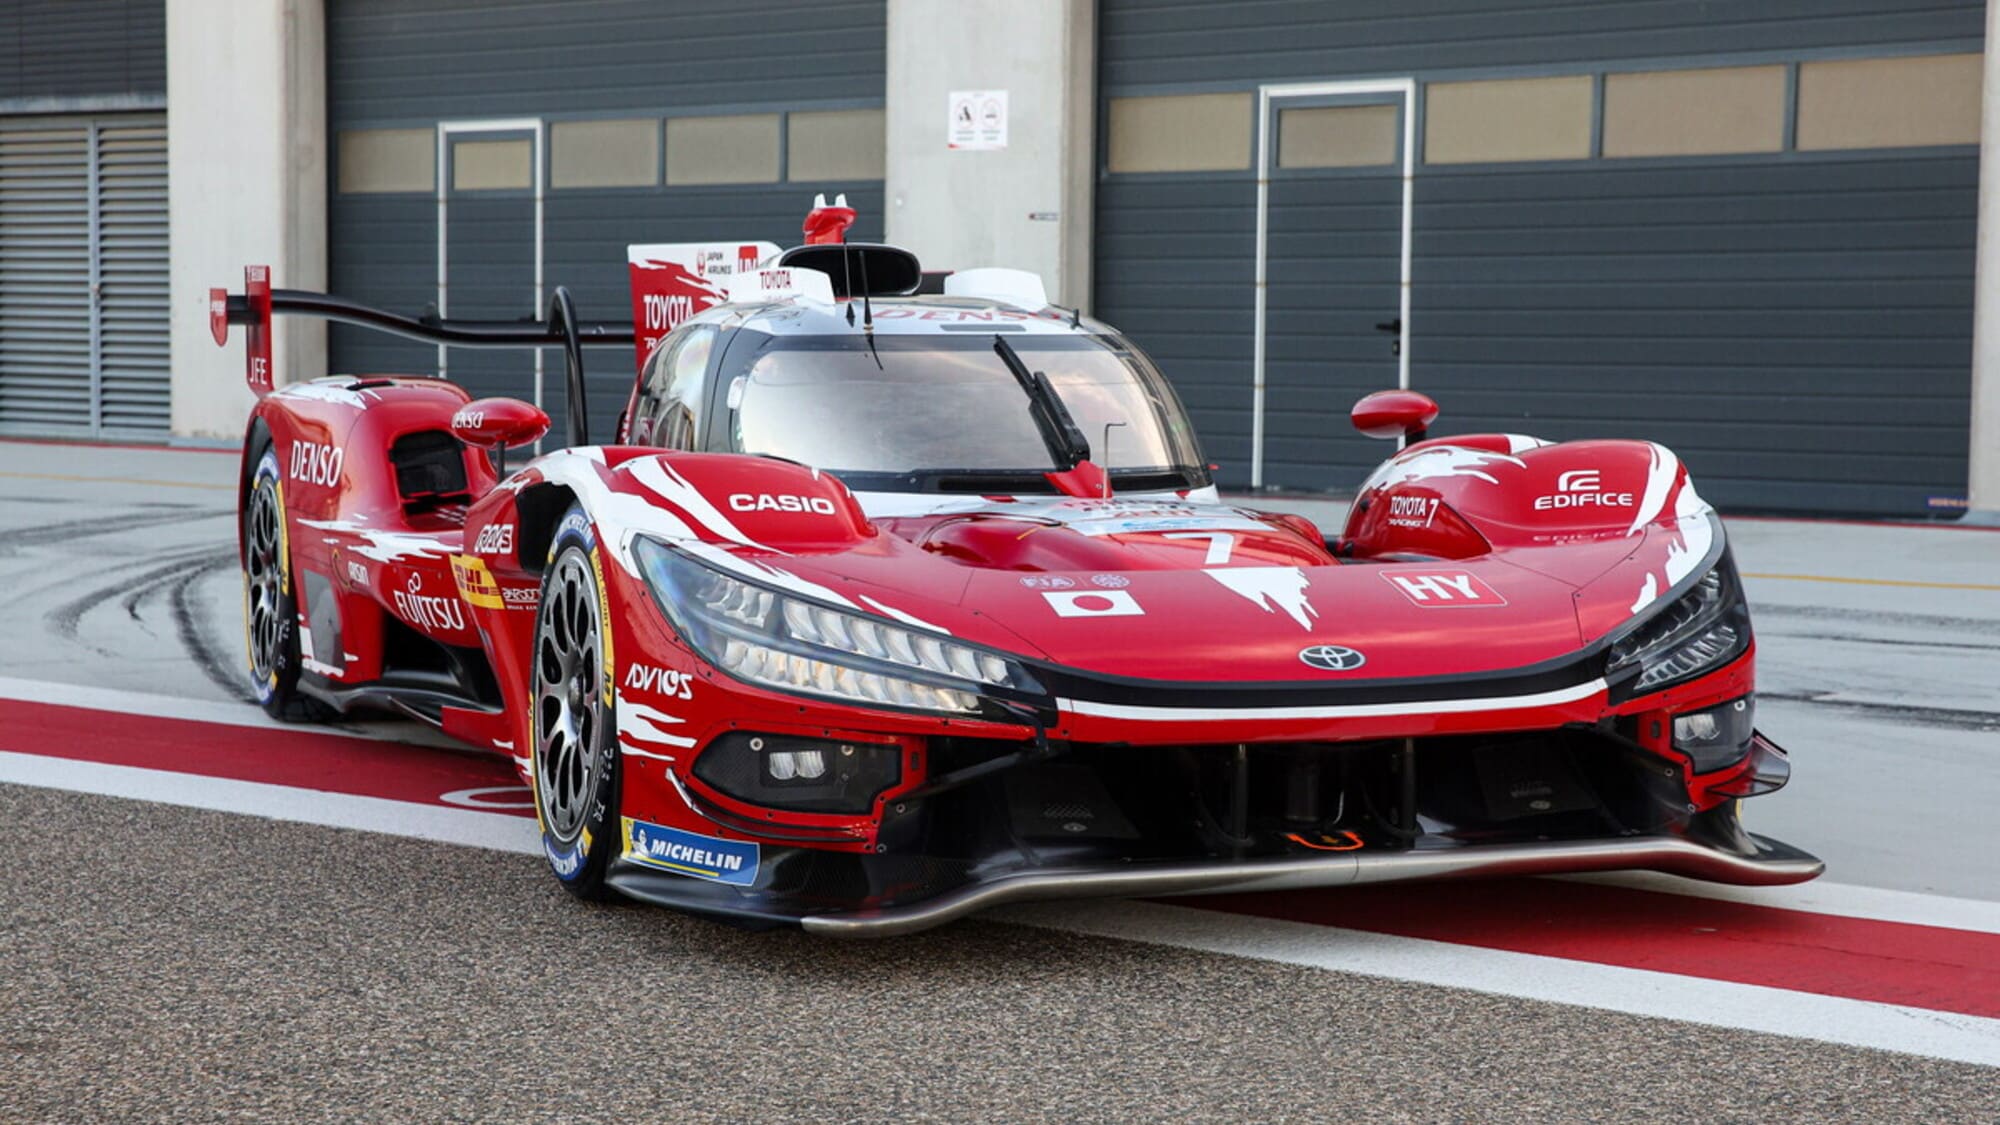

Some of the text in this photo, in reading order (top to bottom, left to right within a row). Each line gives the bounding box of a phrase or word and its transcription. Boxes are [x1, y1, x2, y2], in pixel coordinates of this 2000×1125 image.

[759, 270, 792, 290] TOYOTA
[643, 294, 695, 330] TOYOTA
[249, 356, 267, 385] JFE
[290, 439, 343, 488] DENSO
[728, 493, 836, 515] CASIO
[1390, 496, 1440, 528] TOYOTA 7
[1534, 492, 1633, 510] EDIFICE
[1393, 575, 1481, 600] HY
[394, 590, 465, 634] FUJITSU
[651, 838, 743, 871] MICHELIN
